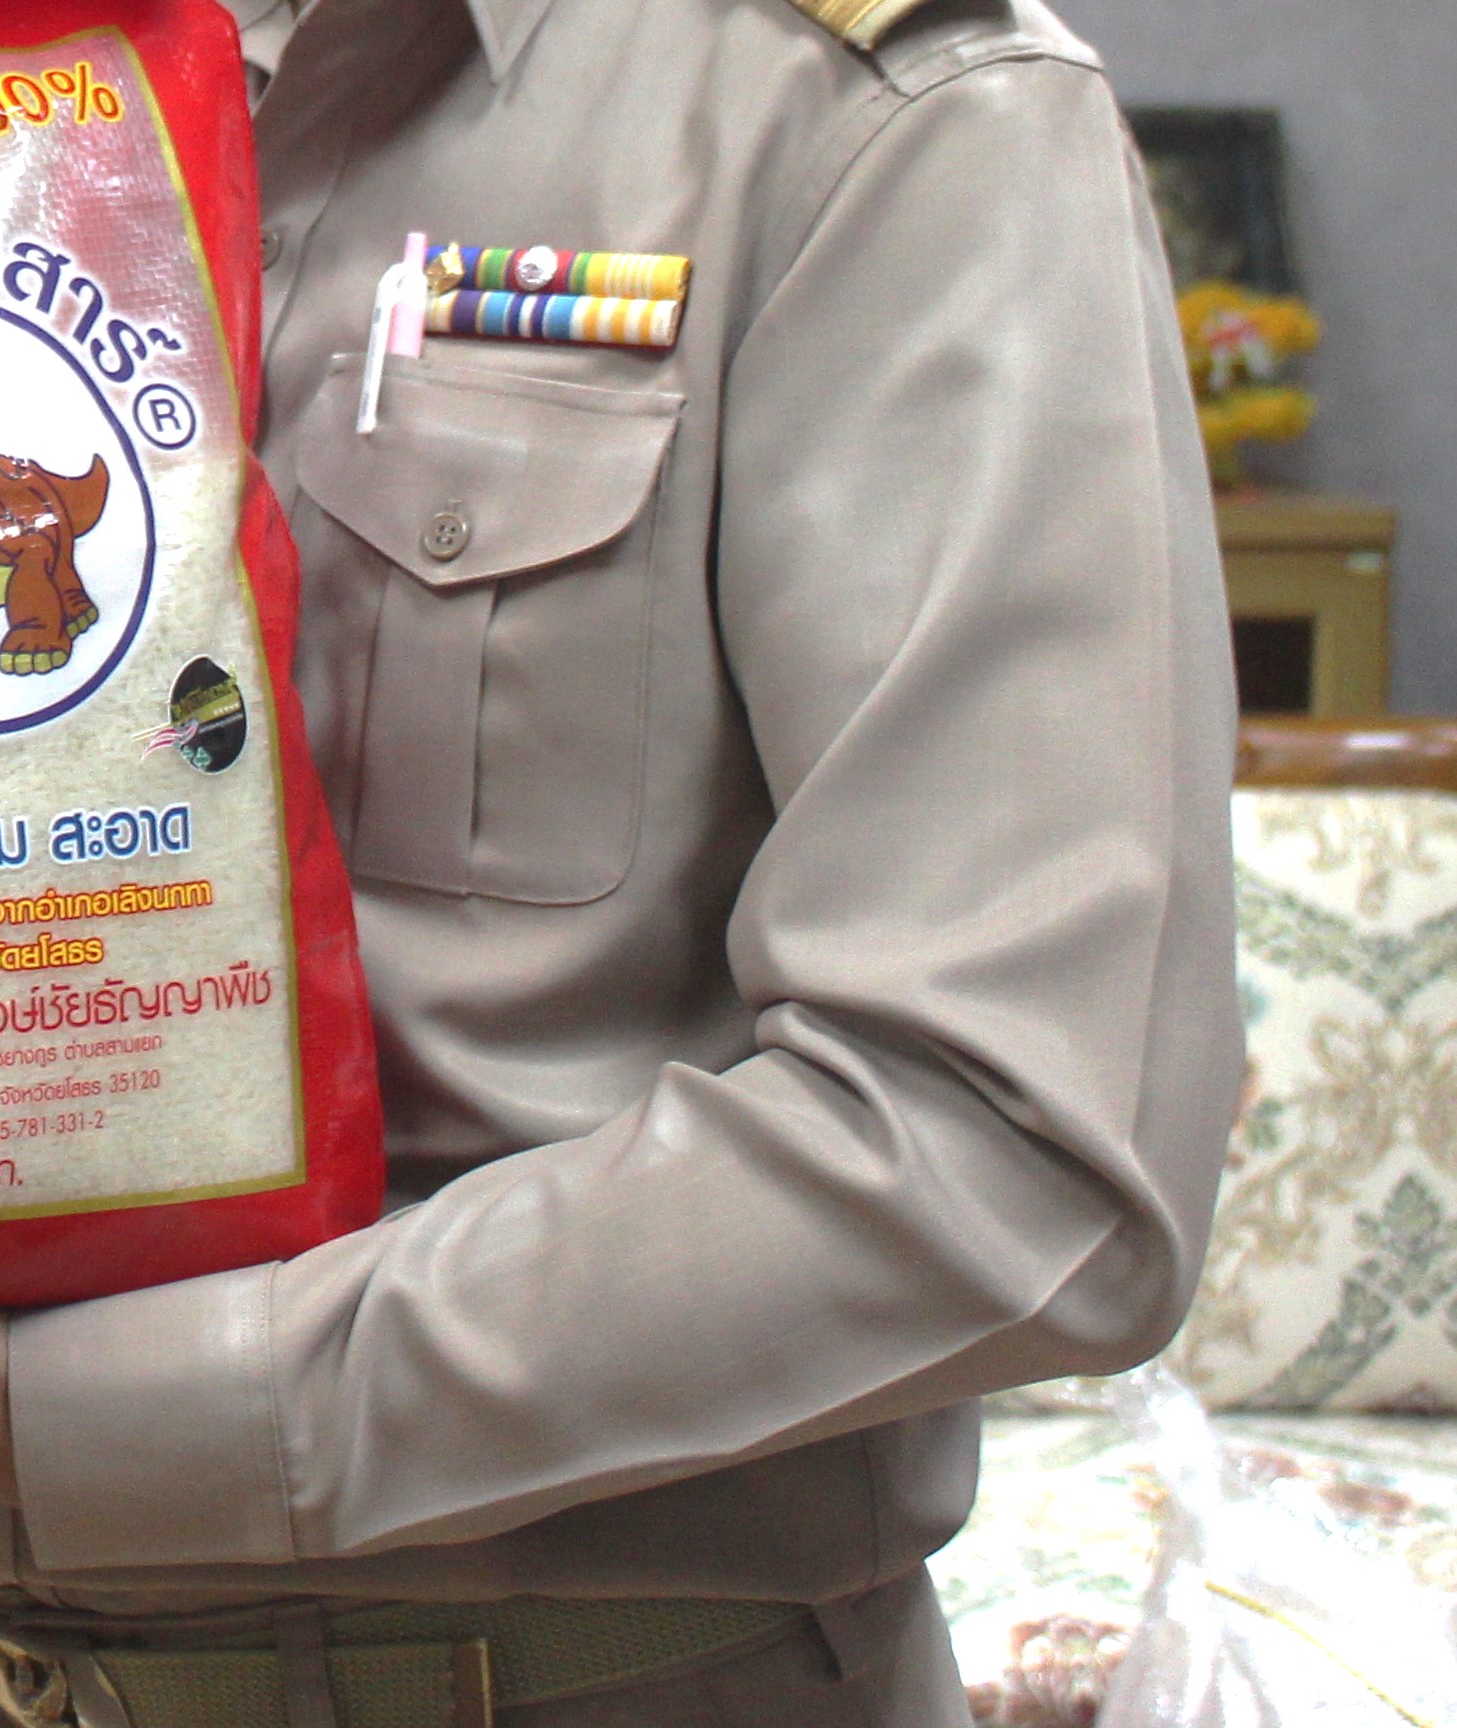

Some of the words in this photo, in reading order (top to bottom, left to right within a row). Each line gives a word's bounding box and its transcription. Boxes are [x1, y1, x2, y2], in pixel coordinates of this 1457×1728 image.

[51, 804, 192, 863] สะอาด
[64, 1032, 162, 1060] ตำบลสามแยก
[0, 1077, 102, 1105] จังหวัดยโสธร
[109, 1069, 161, 1094] 35120
